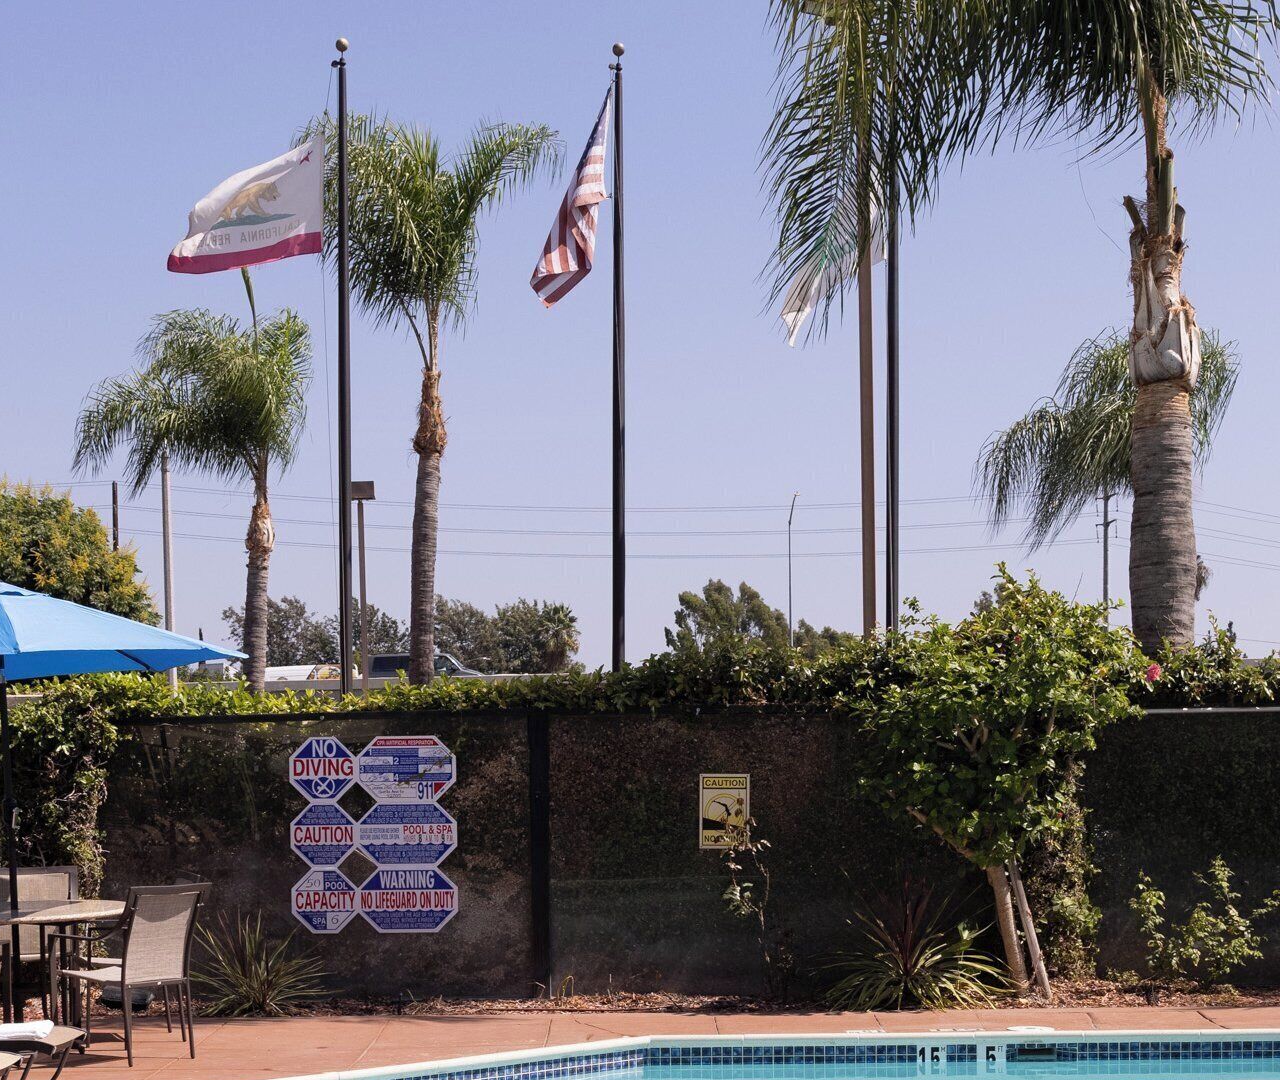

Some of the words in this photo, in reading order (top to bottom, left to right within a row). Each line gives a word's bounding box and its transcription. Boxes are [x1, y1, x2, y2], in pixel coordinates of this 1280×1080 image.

[312, 739, 336, 758] NO
[294, 758, 353, 776] DIVING
[418, 782, 434, 800] 911
[704, 779, 745, 787] CAUTION
[294, 826, 353, 843] CAUTION
[403, 825, 426, 834] POOL
[428, 825, 435, 834] &
[436, 825, 453, 834] SPA
[418, 834, 422, 843] 8
[305, 879, 320, 888] 50
[325, 882, 348, 890] POOL
[380, 871, 435, 889] WARNING
[296, 892, 356, 909] CAPACITY
[361, 892, 372, 909] NO
[375, 892, 417, 909] LIFEGUARD
[420, 891, 431, 908] ON
[434, 891, 454, 908] DUTY
[331, 915, 339, 924] 6
[986, 1046, 996, 1061] 5
